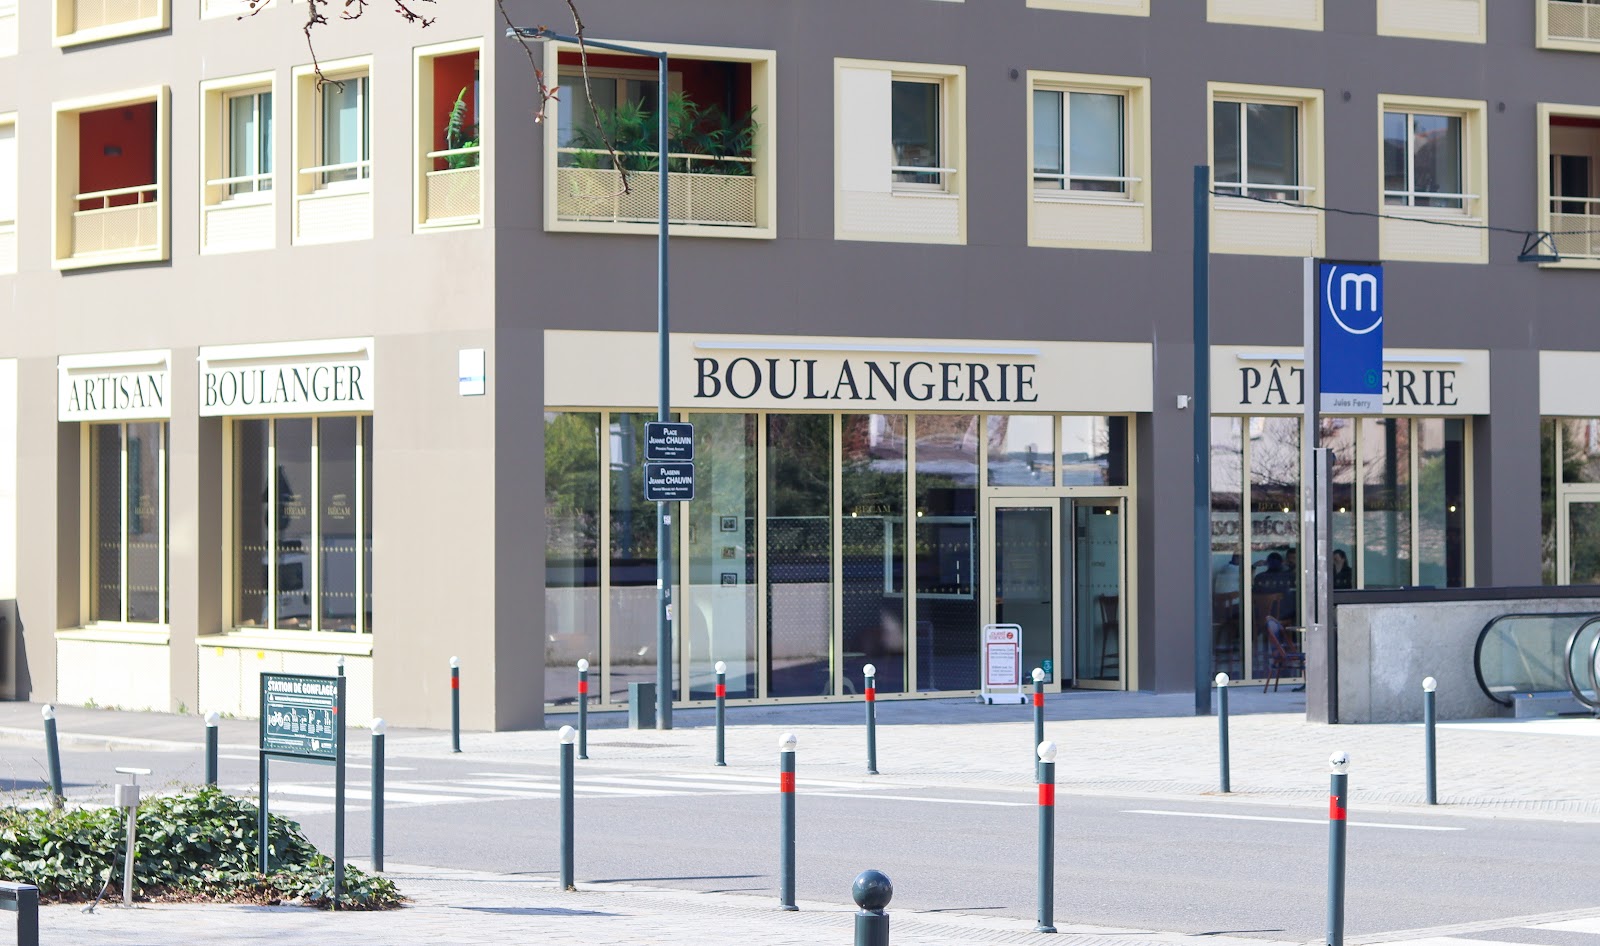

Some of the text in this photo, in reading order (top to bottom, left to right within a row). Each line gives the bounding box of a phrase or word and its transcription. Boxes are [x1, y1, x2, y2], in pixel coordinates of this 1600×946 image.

[205, 365, 365, 407] BOULANGER
[693, 357, 1039, 403] BOULANGERIE
[1239, 359, 1458, 406] PÂTERIE
[68, 373, 164, 412] ARTISAN
[1333, 398, 1371, 409] Jules Ferry
[663, 427, 678, 436] PLACE
[649, 436, 692, 445] JEANNE CHAUVIN
[649, 476, 692, 485] JEANNE CHAUVIN
[268, 680, 334, 696] STATION DE GONFLAGE
